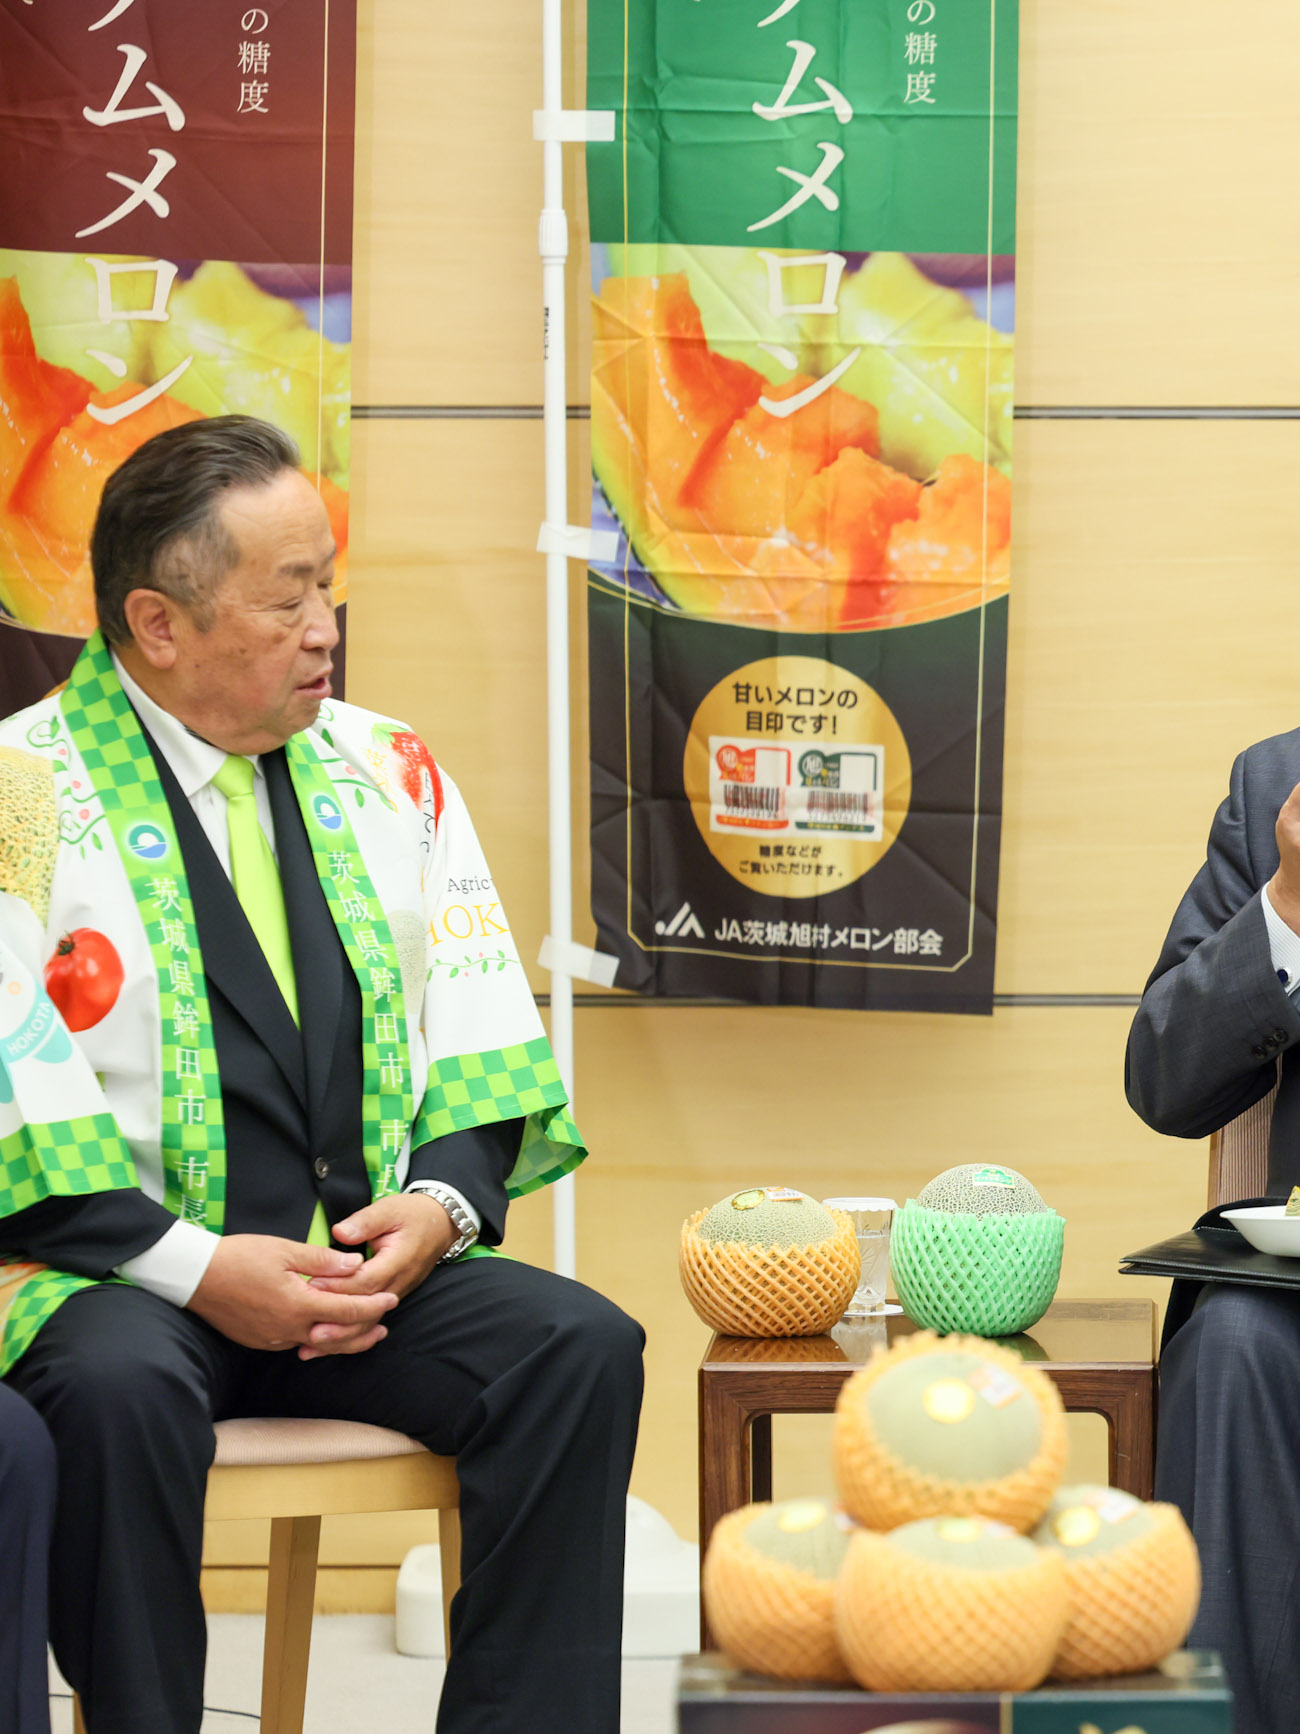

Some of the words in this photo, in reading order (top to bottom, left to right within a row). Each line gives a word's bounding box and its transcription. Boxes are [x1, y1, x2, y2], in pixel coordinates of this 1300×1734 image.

[237, 7, 271, 114] の糖度
[903, 0, 938, 104] の糖度
[732, 681, 858, 709] 甘いメロンの
[324, 850, 404, 1089] 茨城県鉾田市
[714, 917, 944, 956] JA茨城旭村メロン部会
[144, 877, 207, 1125] 茨城県鉾田市
